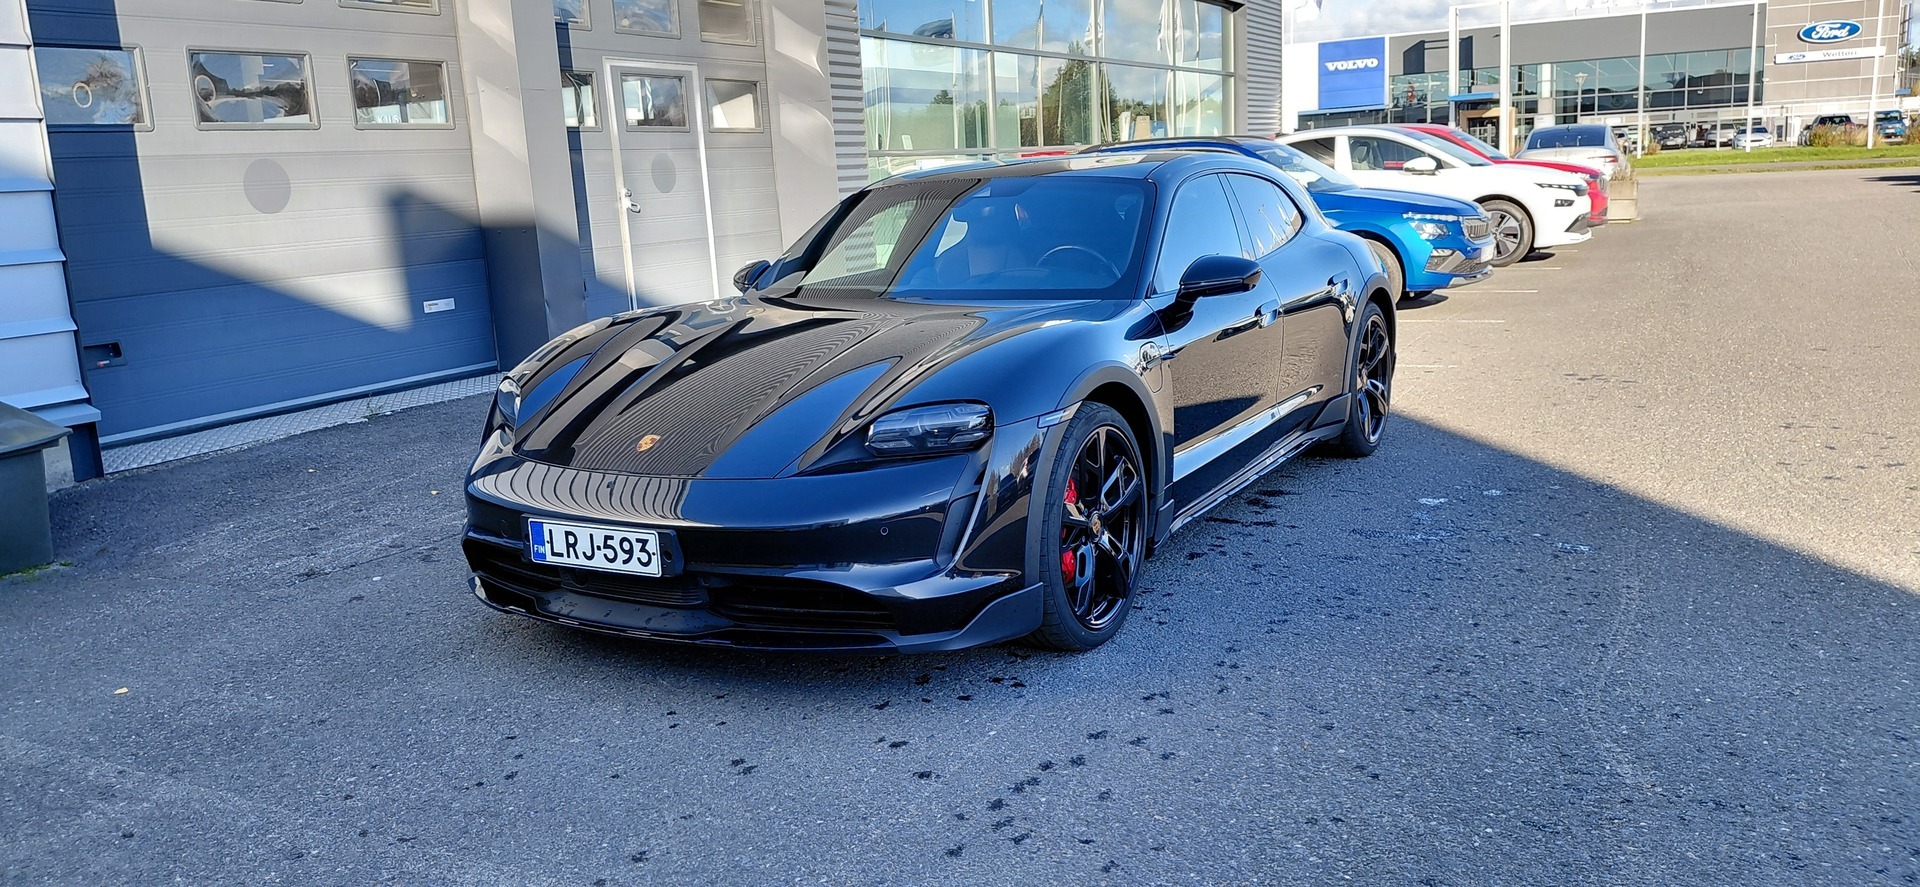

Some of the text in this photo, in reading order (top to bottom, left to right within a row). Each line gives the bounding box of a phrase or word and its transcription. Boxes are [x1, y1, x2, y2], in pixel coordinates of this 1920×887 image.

[1811, 23, 1850, 39] Ford
[1324, 58, 1379, 71] VOLVO
[534, 545, 546, 554] FIN
[548, 529, 653, 567] LRJ-593
